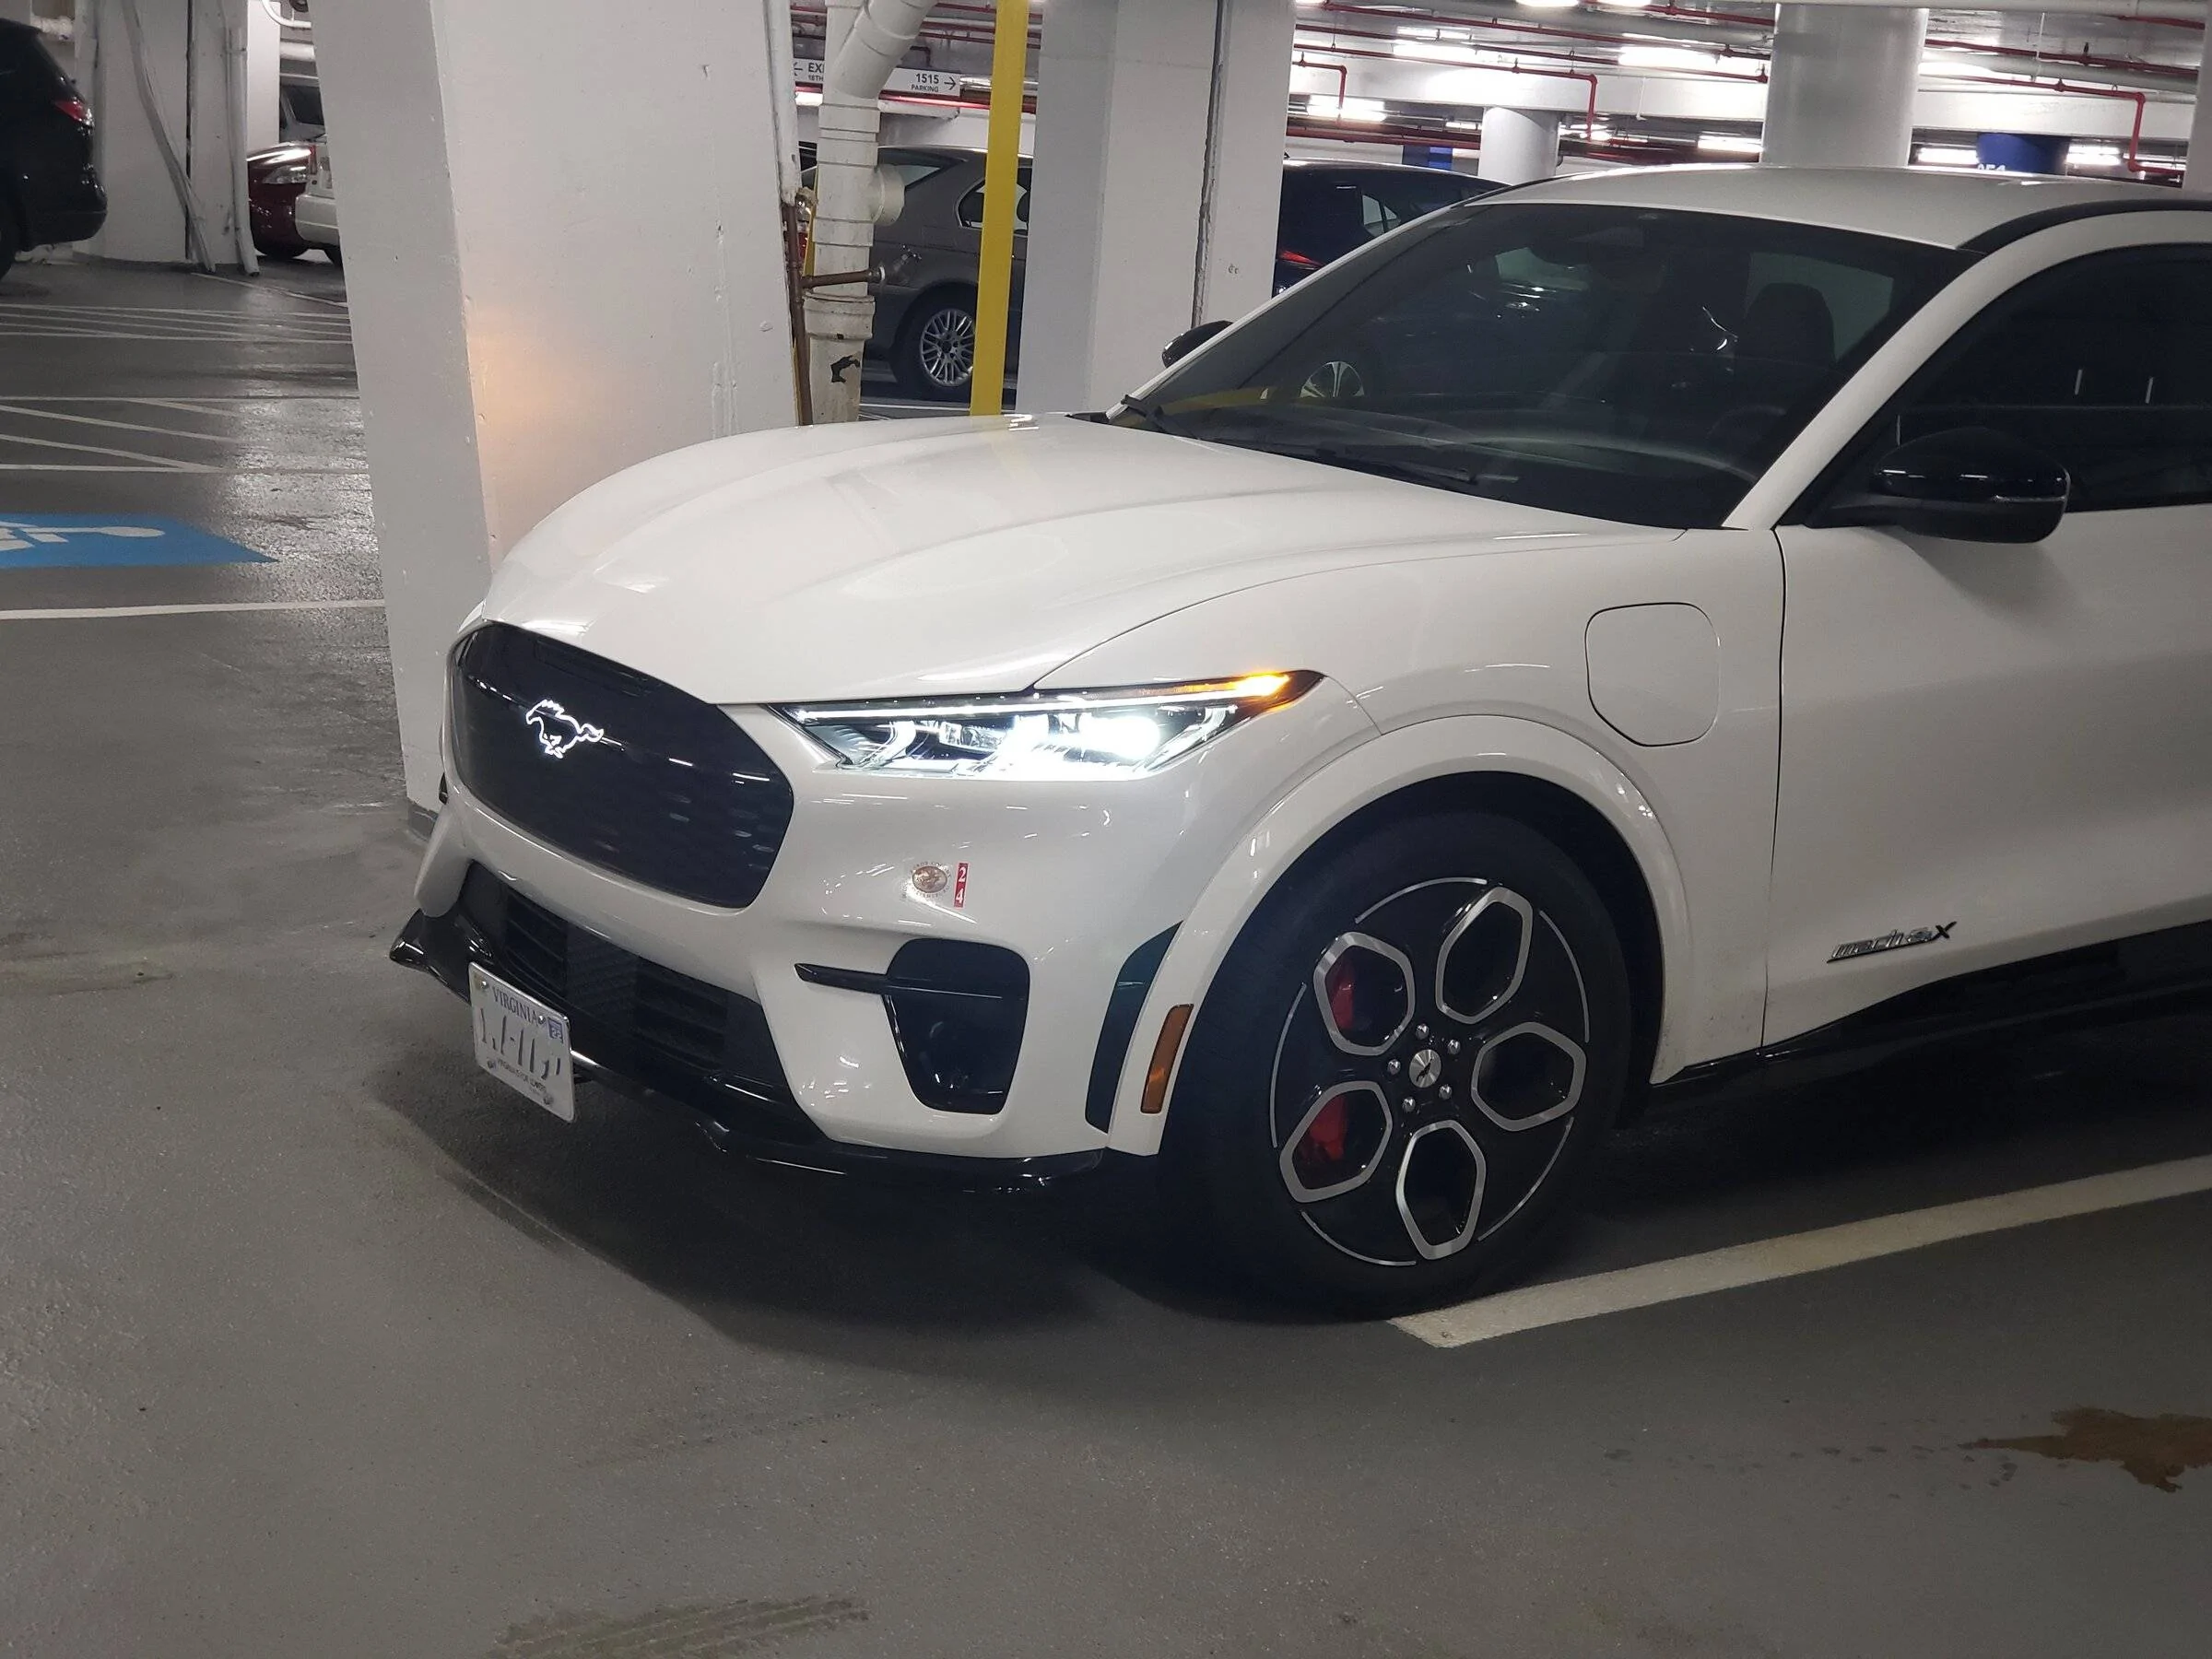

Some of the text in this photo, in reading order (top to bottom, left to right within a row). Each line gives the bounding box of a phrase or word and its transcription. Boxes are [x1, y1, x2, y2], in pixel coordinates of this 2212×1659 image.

[915, 73, 940, 84] 1515
[911, 84, 939, 93] PARKING
[492, 986, 539, 1027] VIRGINIA
